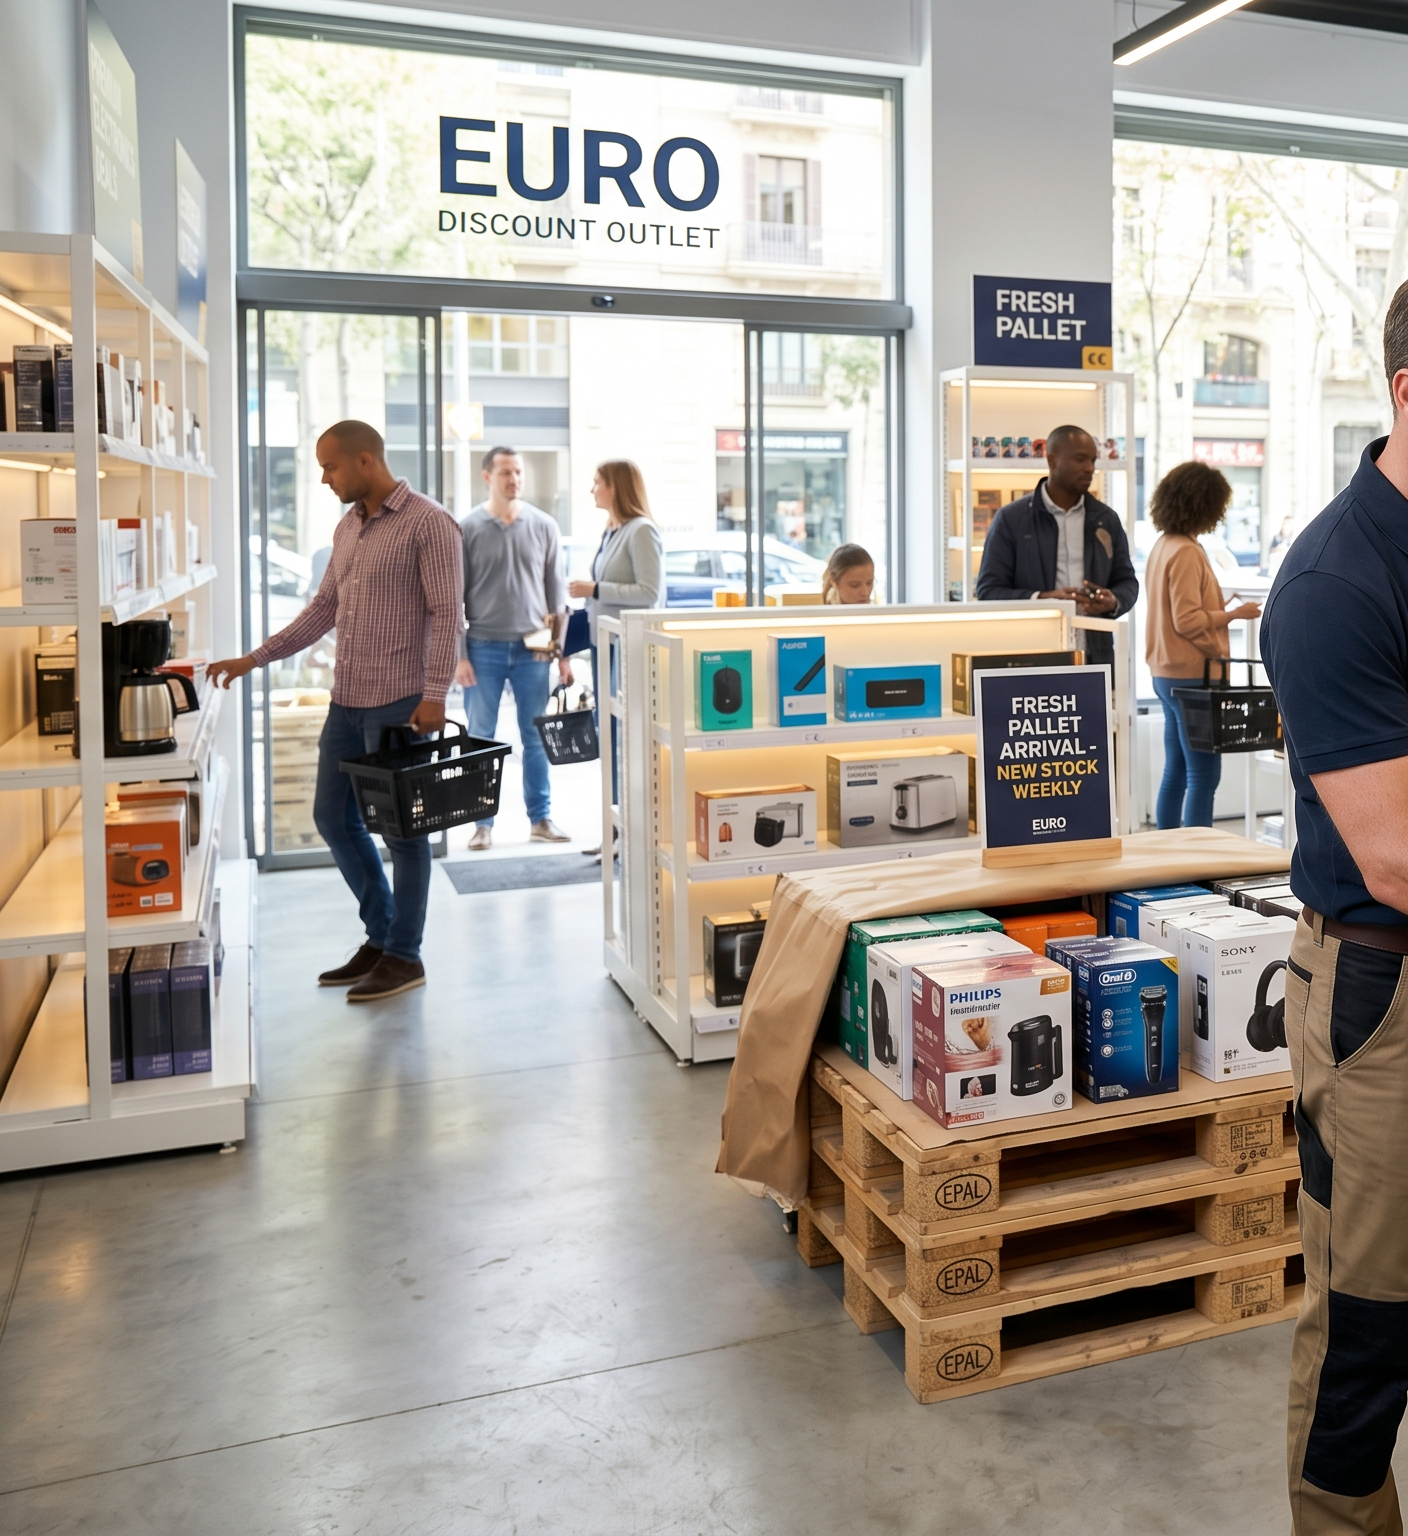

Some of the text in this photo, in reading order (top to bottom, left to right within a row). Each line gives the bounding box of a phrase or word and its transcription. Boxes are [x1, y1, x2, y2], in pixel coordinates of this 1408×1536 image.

[440, 116, 719, 212] EURO
[438, 210, 720, 249] DISCOUNT OUTLET
[996, 289, 1075, 314] FRESH
[996, 316, 1086, 341] PALLET
[1011, 695, 1076, 714] FRESH
[1008, 716, 1082, 736] PALLET
[1000, 738, 1086, 760] ARRIVAL
[997, 759, 1099, 780] NEW STOCK
[1012, 780, 1082, 799] WEEKLY
[1032, 817, 1067, 830] EURO
[1221, 946, 1257, 957] SONY
[950, 988, 1002, 1004] PHILIPS
[944, 1180, 983, 1204] EPAL
[944, 1265, 984, 1289] EPAL
[944, 1350, 983, 1374] EPAL
